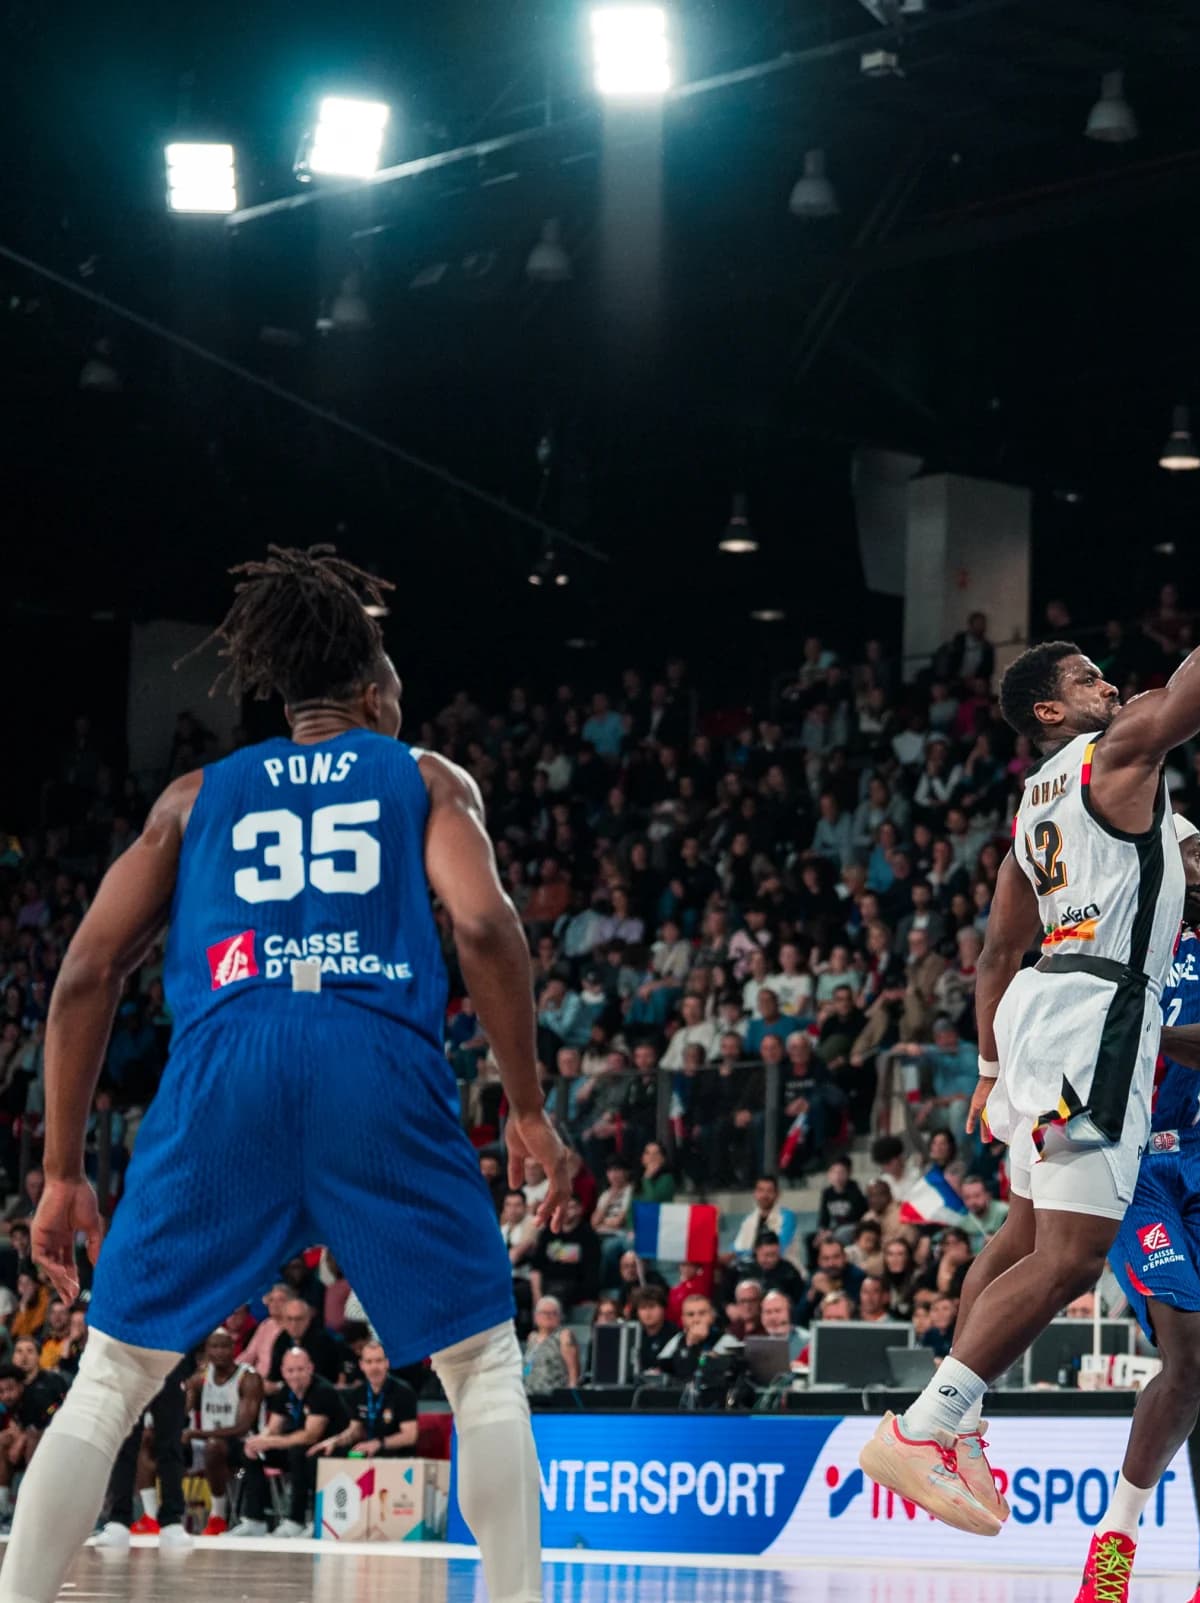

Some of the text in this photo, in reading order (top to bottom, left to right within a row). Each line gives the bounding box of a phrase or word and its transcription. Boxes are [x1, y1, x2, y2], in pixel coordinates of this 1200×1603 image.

[264, 752, 358, 786] PONS
[232, 799, 381, 904] 35
[264, 931, 360, 957] CAISSE
[1148, 1248, 1175, 1261] CAISSE
[538, 1459, 785, 1517] NTERSPORT
